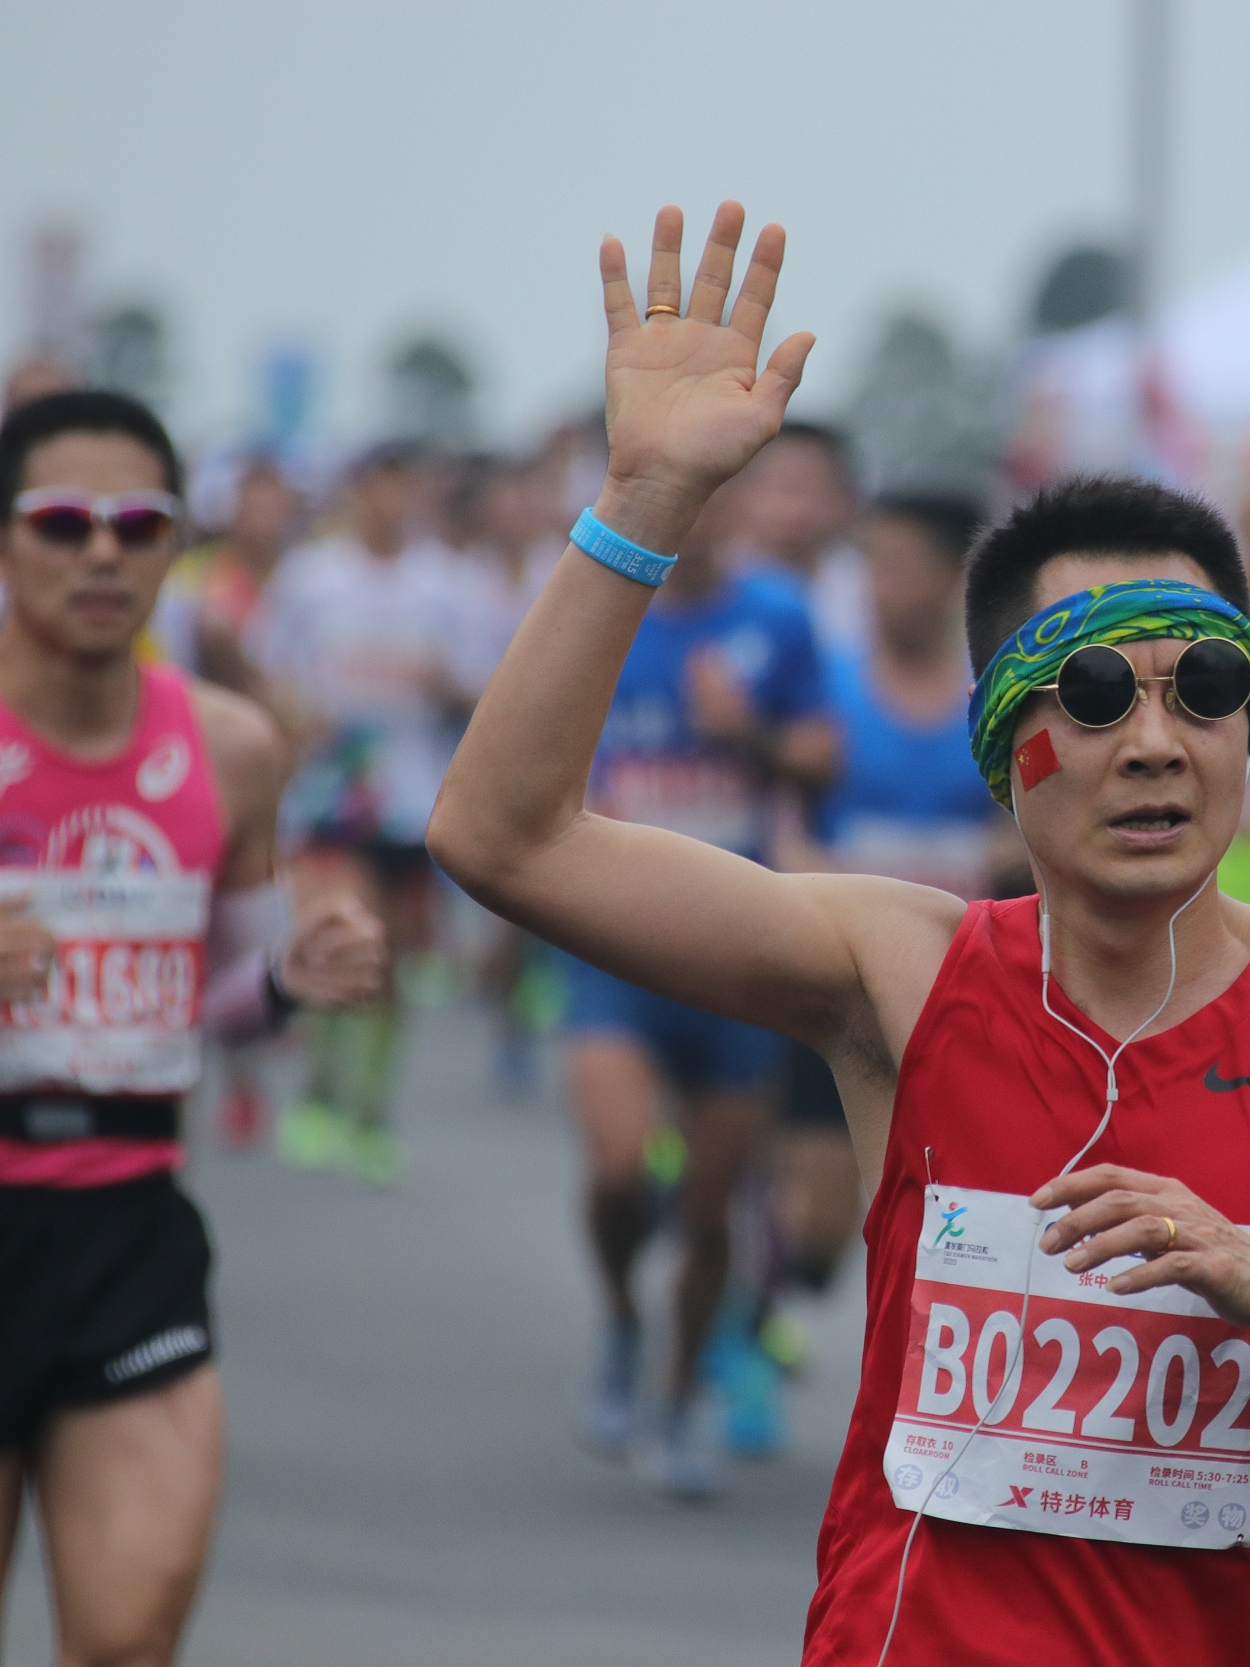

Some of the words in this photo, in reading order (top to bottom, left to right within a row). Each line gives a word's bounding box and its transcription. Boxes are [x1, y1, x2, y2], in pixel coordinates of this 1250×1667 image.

[625, 552, 644, 575] 3:15
[906, 1434, 937, 1449] 存取衣
[942, 1440, 954, 1451] 10
[903, 1446, 950, 1459] CLOAKROOM
[1023, 1451, 1057, 1467] 检录区
[1080, 1459, 1089, 1470] B
[1022, 1463, 1043, 1474] ROLL
[1045, 1467, 1065, 1477] CALL
[1066, 1470, 1089, 1479] ZONE
[1150, 1466, 1195, 1480] 检录时间
[1197, 1471, 1249, 1484] 5:30-7:25
[1148, 1478, 1169, 1488] ROLL
[1171, 1480, 1191, 1489] CALL
[1193, 1482, 1213, 1491] TIME
[1040, 1490, 1135, 1521] 特步体育
